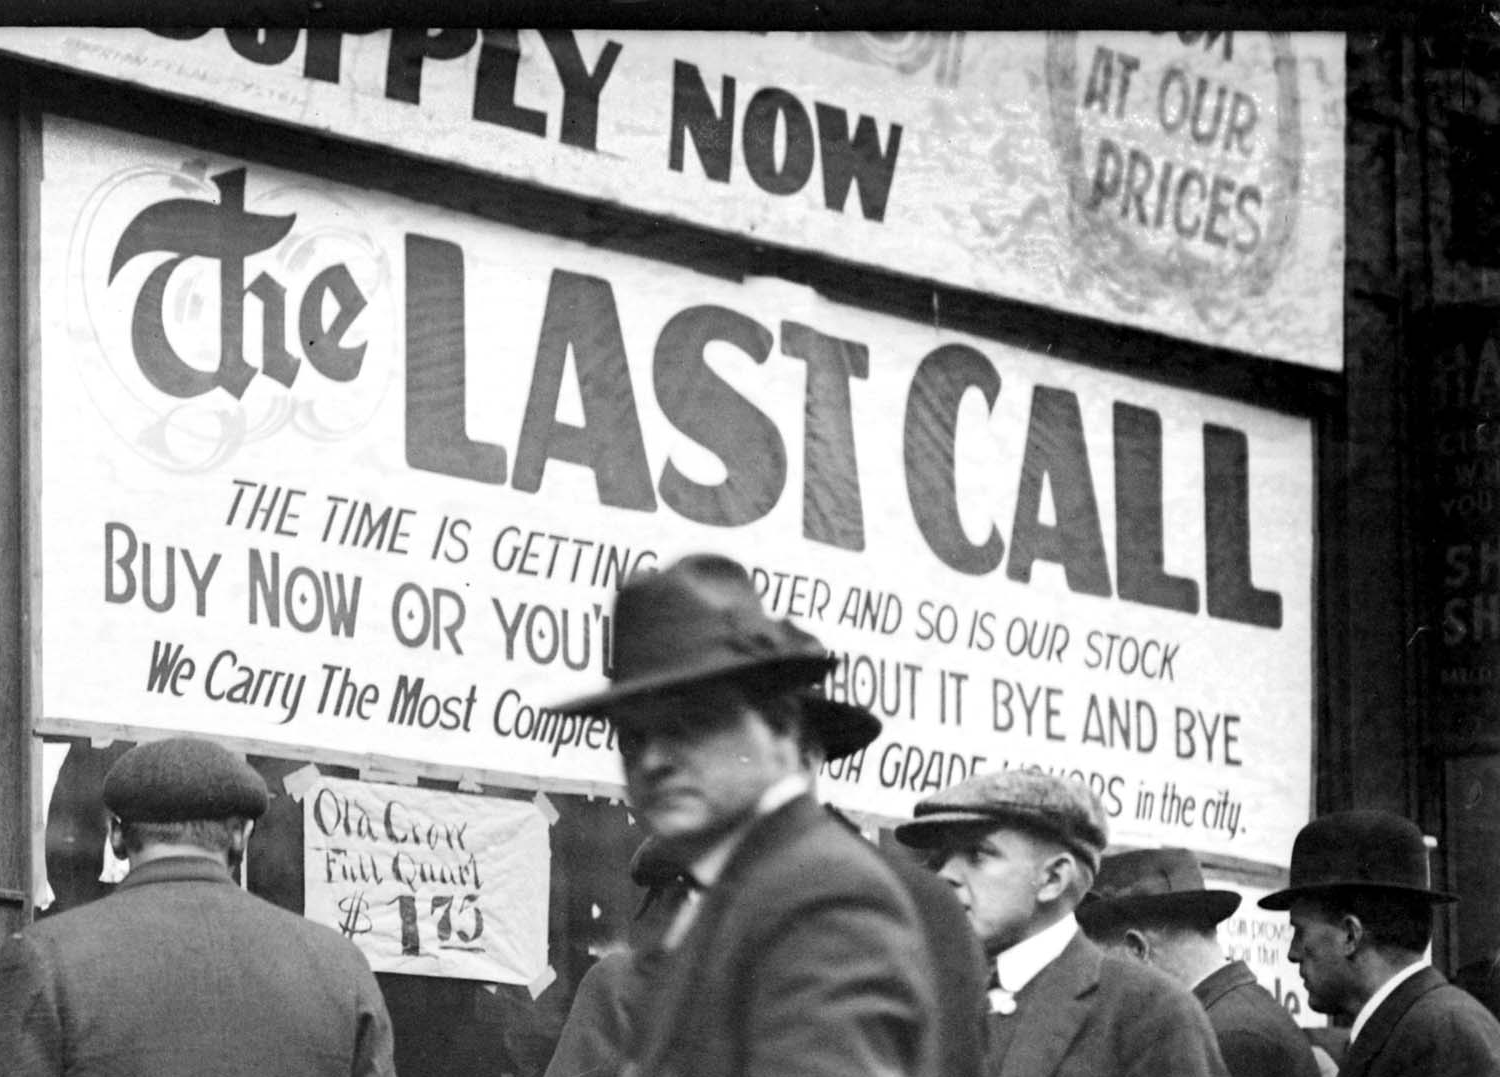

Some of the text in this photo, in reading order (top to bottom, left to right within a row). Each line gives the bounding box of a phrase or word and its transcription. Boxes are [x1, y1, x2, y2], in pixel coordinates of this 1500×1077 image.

[138, 29, 623, 152] PPLY
[668, 58, 903, 223] NOW
[1084, 45, 1259, 158] AT OUR
[1085, 137, 1262, 254] PRICES
[404, 232, 870, 553] LAST
[904, 343, 1283, 630] CALL
[104, 522, 222, 618] BUY
[248, 547, 363, 638] NOW
[391, 582, 467, 656] OR
[940, 669, 969, 727] IT
[992, 678, 1067, 742] BYE
[1082, 695, 1159, 755] AND
[1174, 706, 1243, 768] BYE
[226, 479, 307, 538] THE
[321, 496, 418, 554] TIME
[432, 515, 472, 564] IS
[751, 567, 832, 622] RTER
[838, 586, 903, 635] AND
[916, 601, 959, 645] SO
[968, 608, 997, 651] IS
[1005, 616, 1070, 665] OUR
[1084, 630, 1182, 682] STOCK
[146, 640, 195, 697] We
[204, 650, 305, 726] Carry
[317, 664, 380, 723] The
[387, 675, 478, 733] Most
[1134, 780, 1155, 821] in
[1160, 781, 1197, 828] the
[1202, 789, 1247, 840] city.
[313, 787, 467, 850] Old Crow
[312, 847, 485, 892] Full Quart
